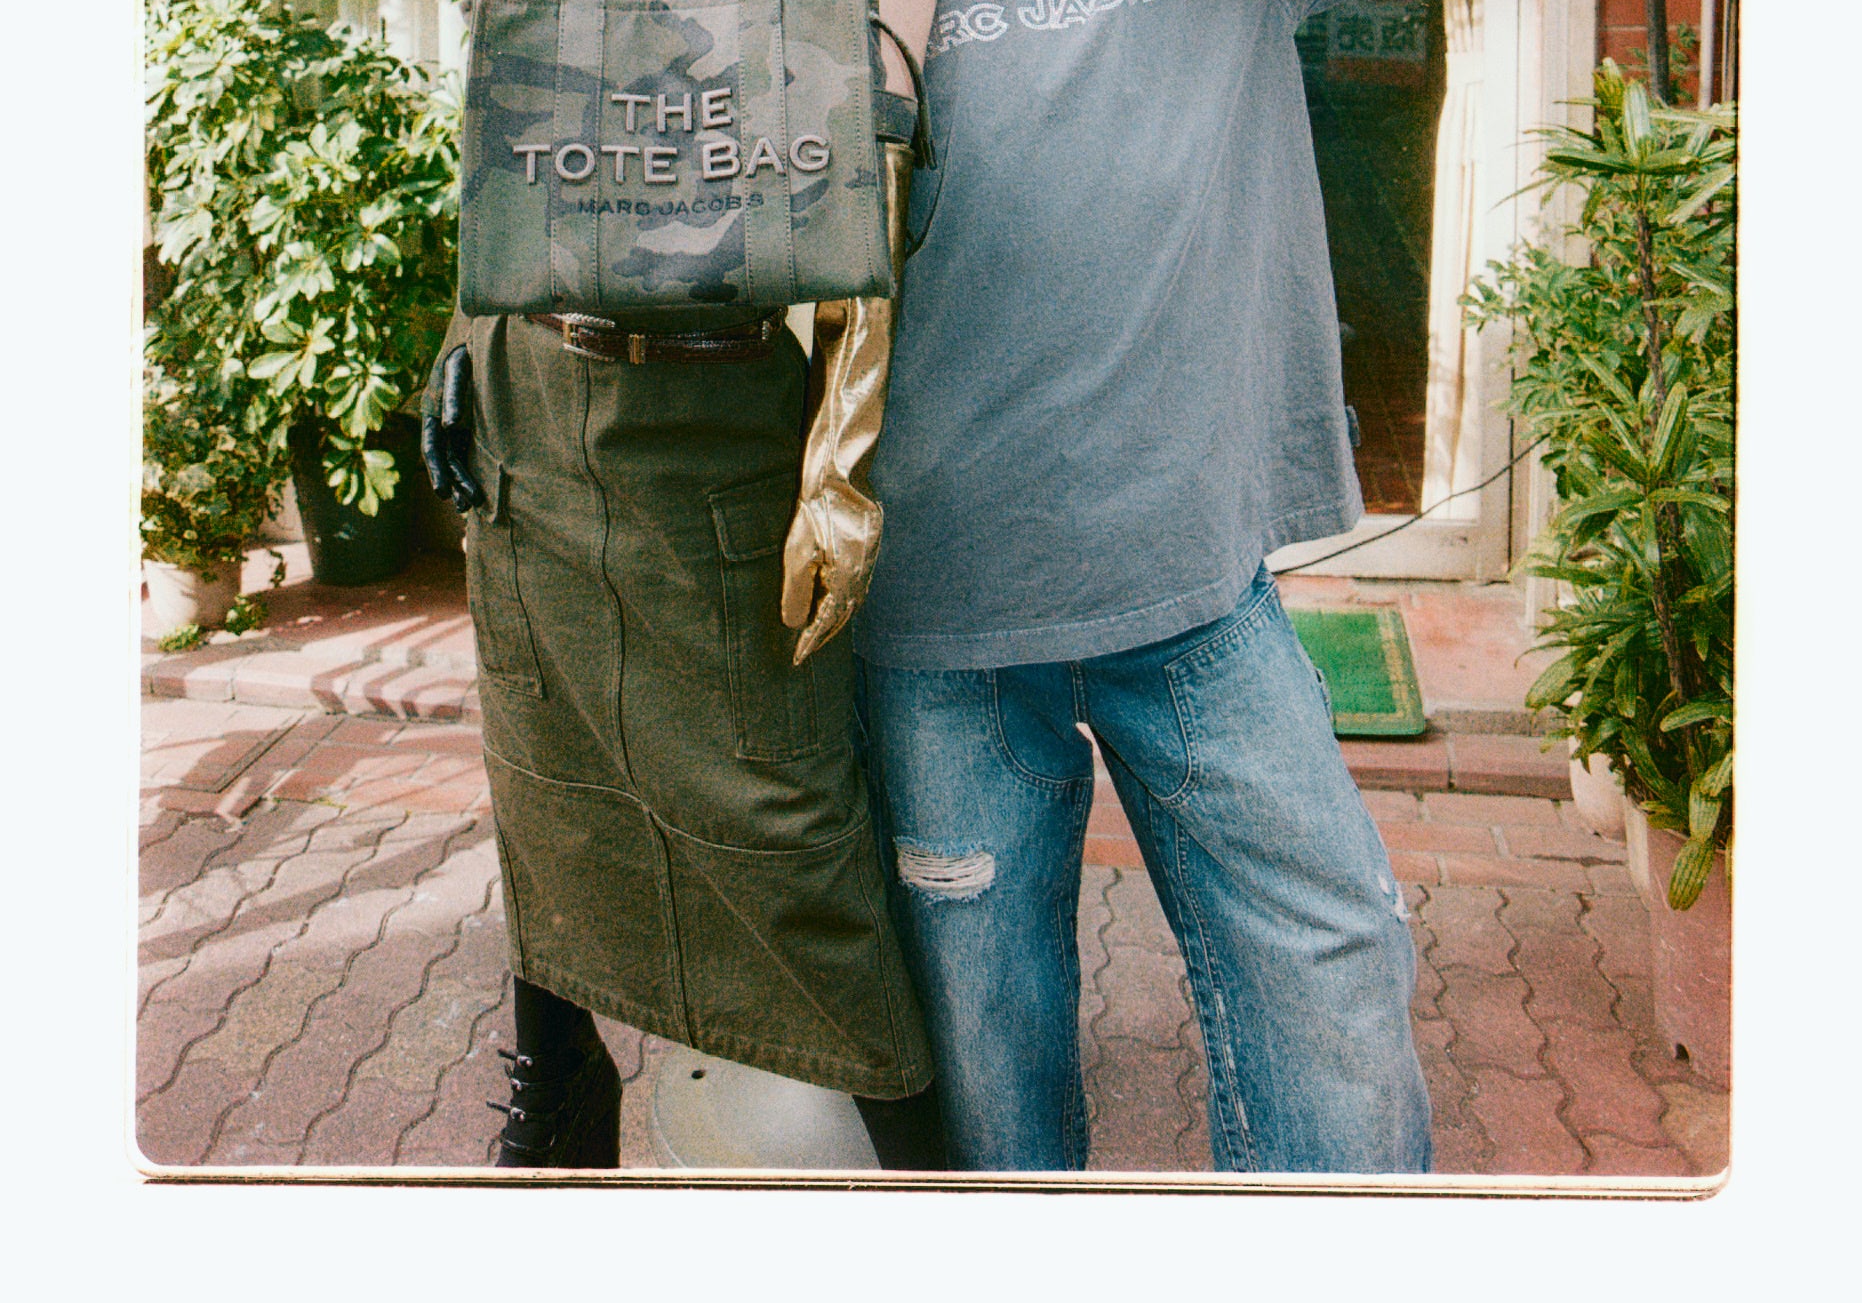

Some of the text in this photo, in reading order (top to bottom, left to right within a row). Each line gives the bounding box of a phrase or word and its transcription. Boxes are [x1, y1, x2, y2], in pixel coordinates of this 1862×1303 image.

[924, 2, 1009, 56] RC
[611, 87, 733, 133] THE
[512, 134, 831, 185] TOTE BAG
[577, 192, 765, 216] MARC JACOBS
